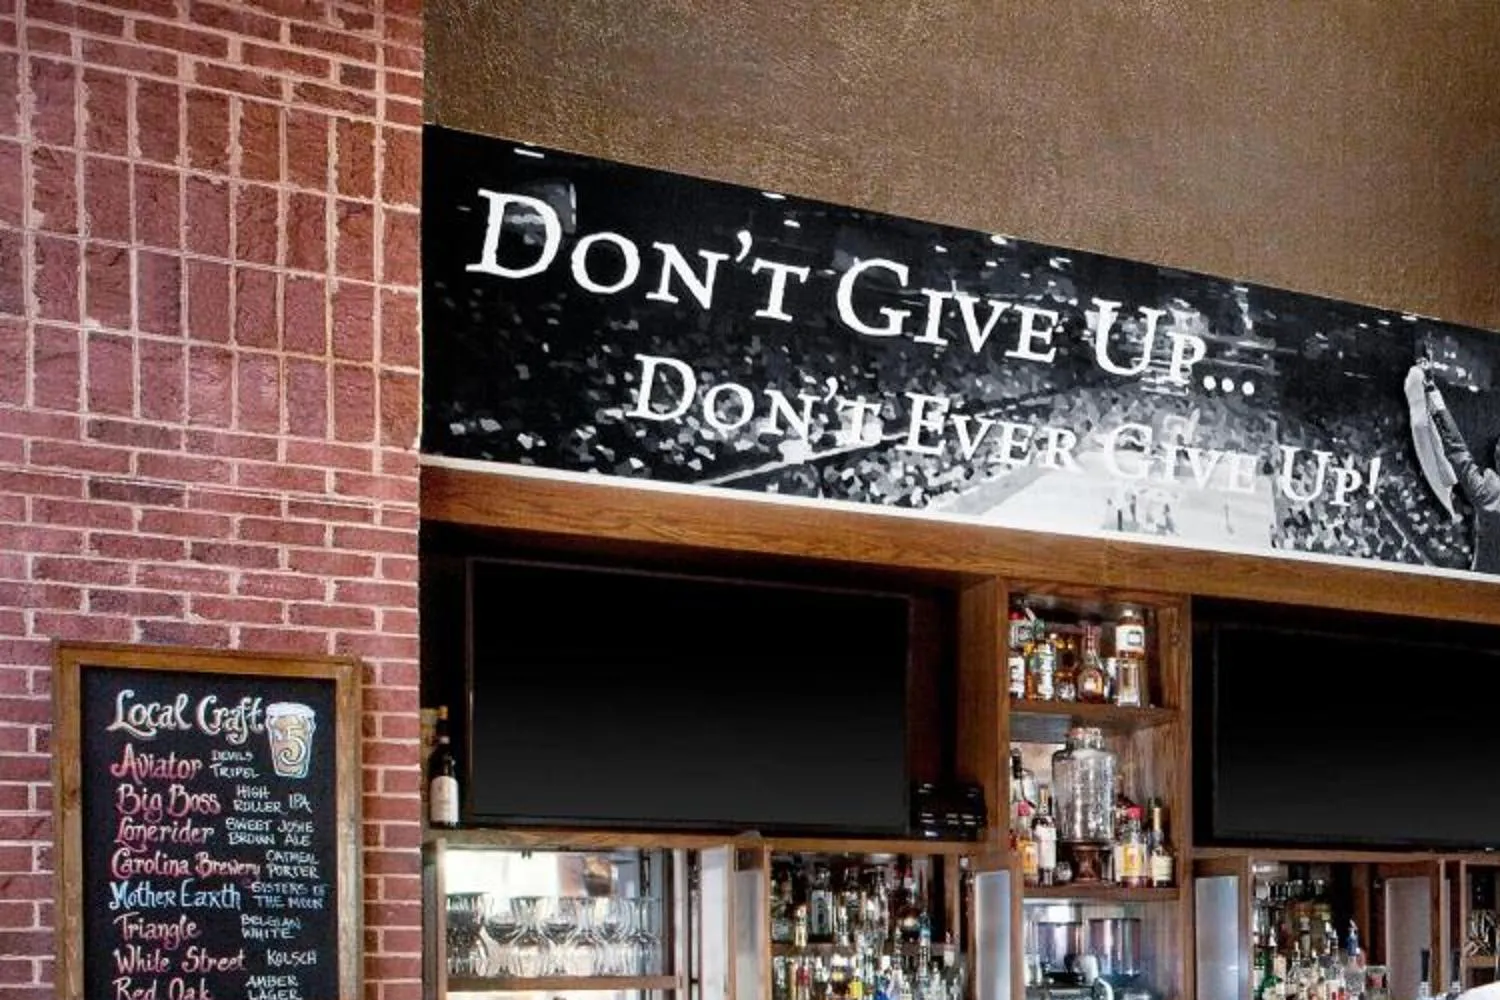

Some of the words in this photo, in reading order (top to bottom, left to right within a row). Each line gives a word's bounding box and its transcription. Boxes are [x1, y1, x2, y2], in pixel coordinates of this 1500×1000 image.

[465, 188, 809, 323] DON'T
[836, 256, 1060, 364] GIVE
[1085, 298, 1255, 396] UP...
[625, 353, 882, 449] DON'T
[904, 391, 1082, 473] EVER
[1103, 422, 1258, 495] GIVE
[1278, 444, 1382, 511] UP!
[105, 689, 193, 740] Local
[196, 695, 265, 745] Craft
[110, 743, 203, 785] Aviator
[211, 749, 254, 762] DEVILS
[209, 762, 261, 779] TRIPEL
[236, 784, 271, 799] HIGH
[116, 783, 163, 823] Big
[167, 783, 222, 818] Boss
[233, 799, 286, 814] ROLLER
[289, 793, 313, 813] IPA
[225, 818, 272, 832] SWEET
[114, 816, 215, 853] Lonerider
[228, 832, 275, 845] BROWN
[284, 833, 311, 847] ALE
[111, 847, 192, 879] Carolina
[195, 851, 261, 880] Brewery
[266, 864, 320, 879] PORTER
[108, 879, 177, 910] Mother
[181, 877, 241, 911] Earth
[250, 881, 308, 896] SISTERS
[252, 895, 285, 908] THE
[288, 897, 324, 910] MOON
[240, 913, 302, 929] BELGIAN
[112, 911, 201, 950] Triangle
[241, 927, 296, 940] WHITE
[112, 944, 171, 975] White
[181, 945, 247, 974] Street
[267, 949, 317, 967] KOLSCH
[245, 975, 298, 988] AMBER
